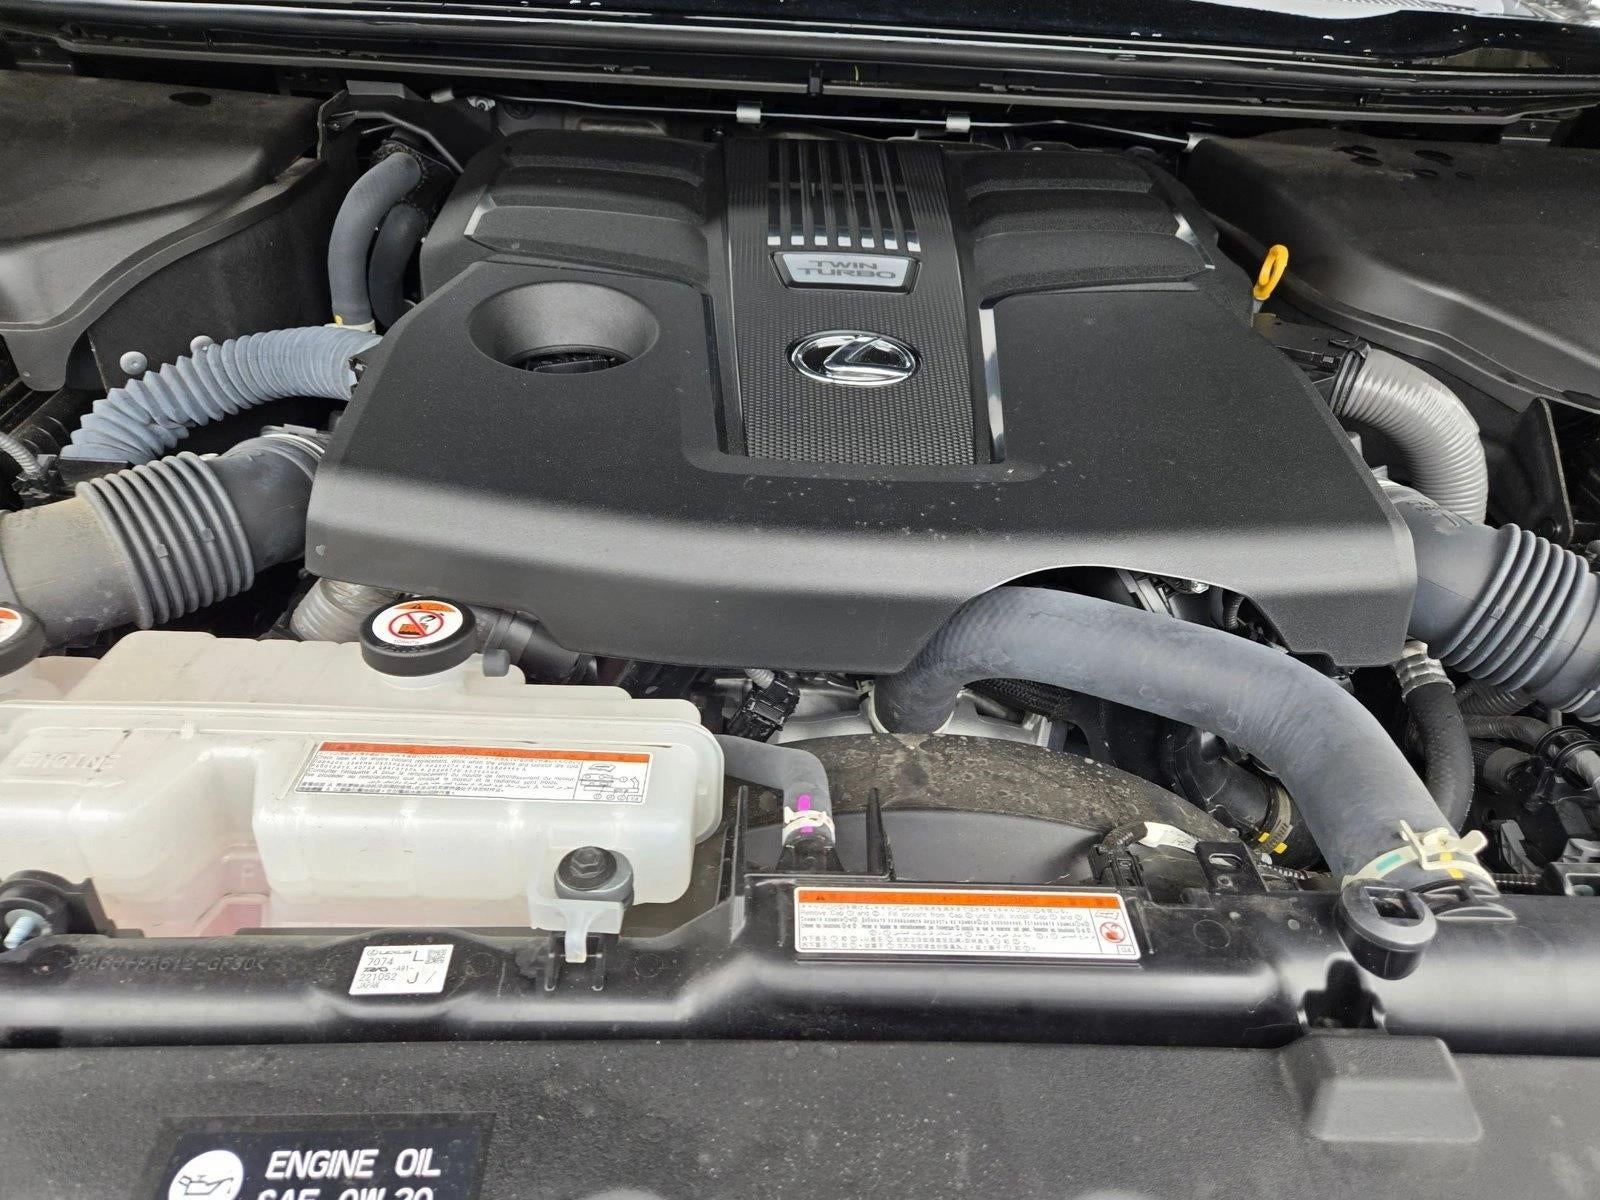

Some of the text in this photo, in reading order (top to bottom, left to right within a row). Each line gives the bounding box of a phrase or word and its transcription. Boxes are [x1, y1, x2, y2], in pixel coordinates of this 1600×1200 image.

[809, 260, 878, 270] TWIN
[797, 267, 897, 279] TURBO
[367, 957, 394, 966] 7074
[413, 950, 424, 962] L
[359, 972, 398, 982] 221052
[265, 1148, 441, 1179] ENGINE OIL
